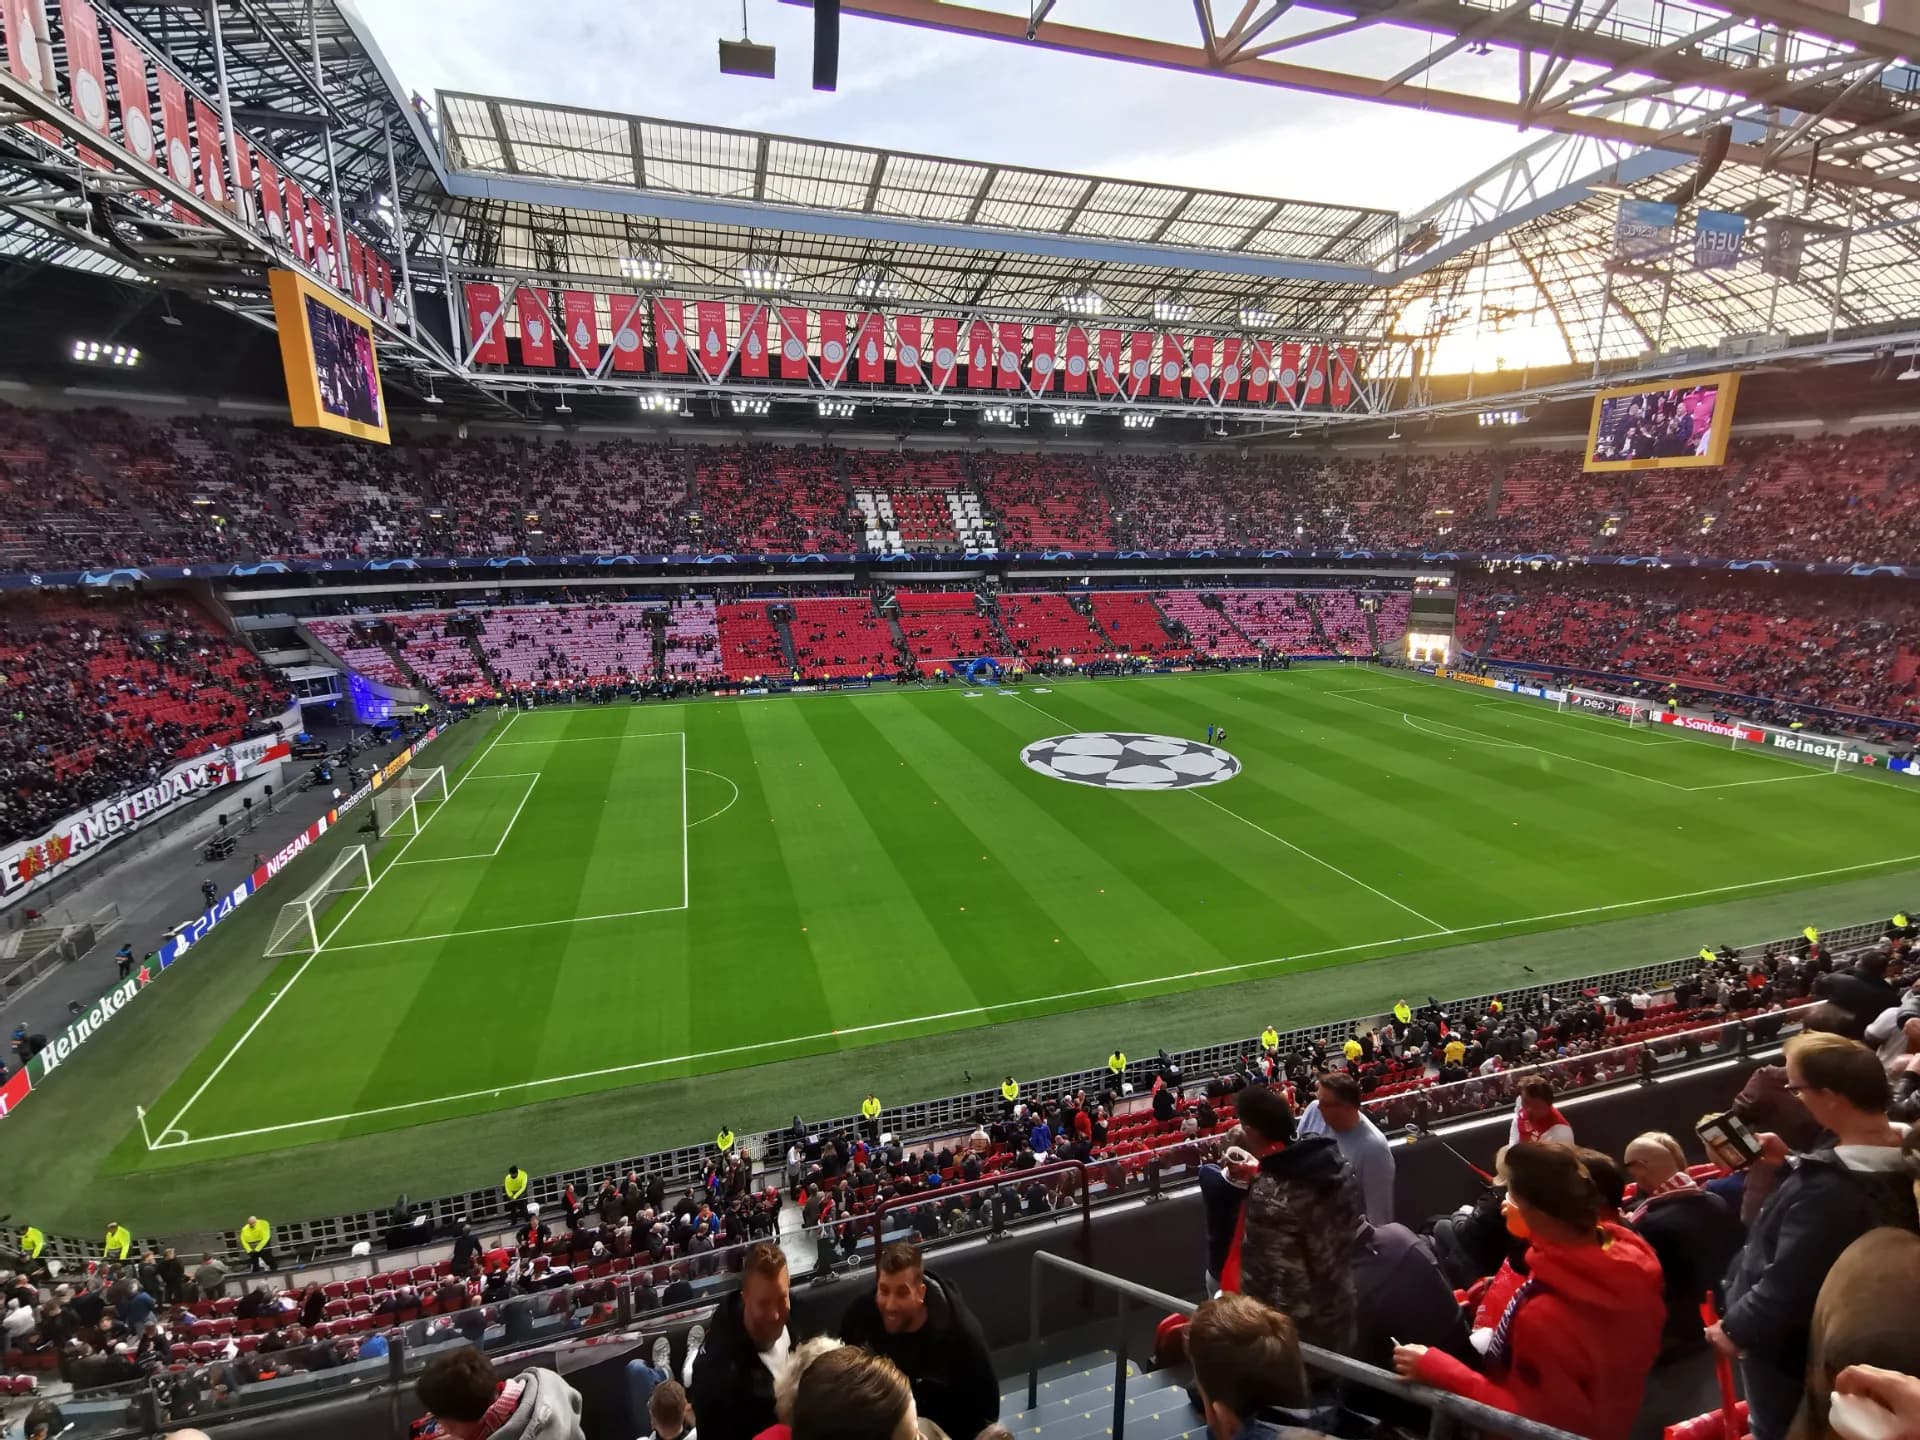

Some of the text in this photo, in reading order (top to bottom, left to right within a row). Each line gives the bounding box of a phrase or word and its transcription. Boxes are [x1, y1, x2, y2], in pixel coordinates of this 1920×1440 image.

[1455, 671, 1485, 686] Expedia
[1685, 717, 1750, 739] Santander
[1773, 734, 1859, 764] Heineken
[67, 764, 211, 855] AMSTERDAM
[337, 781, 373, 817] mastercard
[266, 830, 311, 878] NISSAN
[192, 895, 233, 941] PS4
[39, 979, 138, 1076] Heineken
